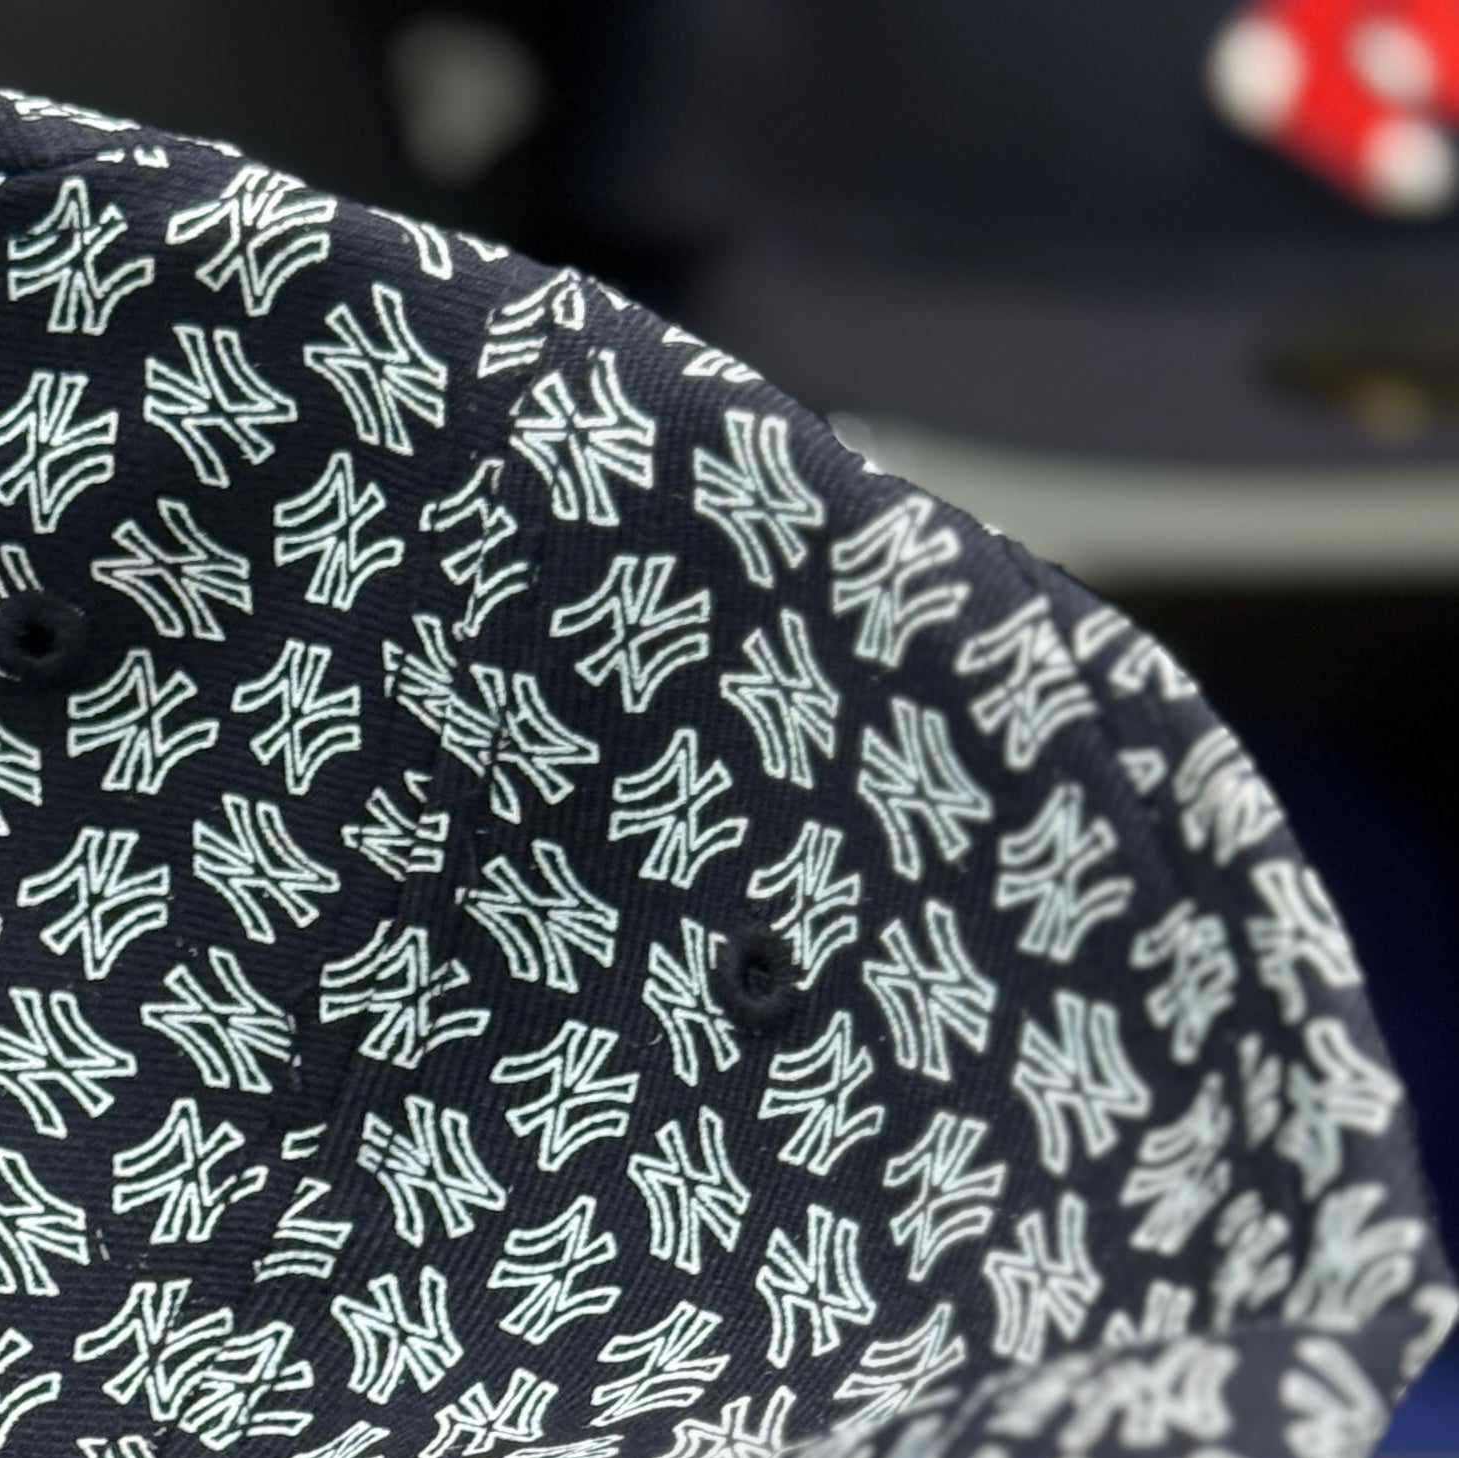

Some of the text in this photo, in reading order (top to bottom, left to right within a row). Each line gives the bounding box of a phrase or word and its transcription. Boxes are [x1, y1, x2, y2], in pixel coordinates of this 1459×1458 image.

[10, 178, 153, 334] NY
[166, 165, 336, 315] NY
[145, 327, 296, 486] NY
[305, 284, 446, 454] NY
[93, 501, 250, 639] NY
[276, 454, 403, 609] NY
[695, 397, 823, 587] NY
[552, 557, 709, 711] NY
[832, 492, 974, 667] NY
[69, 651, 217, 793] NY
[233, 640, 360, 793] NY
[721, 610, 838, 787] NY
[610, 730, 747, 887] NY
[859, 699, 990, 879] NY
[19, 829, 171, 978] NY
[194, 795, 339, 942] NY
[458, 841, 617, 991] NY
[997, 787, 1131, 960] NY
[142, 948, 299, 1092] NY
[864, 901, 995, 1080] NY
[492, 1022, 638, 1170] NY
[760, 1012, 883, 1174] NY
[1014, 992, 1149, 1174] NY
[114, 1099, 267, 1243] NY
[629, 1107, 749, 1273] NY
[885, 1112, 1005, 1280] NY
[332, 1267, 462, 1403] NY
[489, 1197, 620, 1343] NY
[757, 1205, 876, 1372] NY
[984, 1193, 1102, 1364] NY
[590, 1298, 732, 1426] NY
